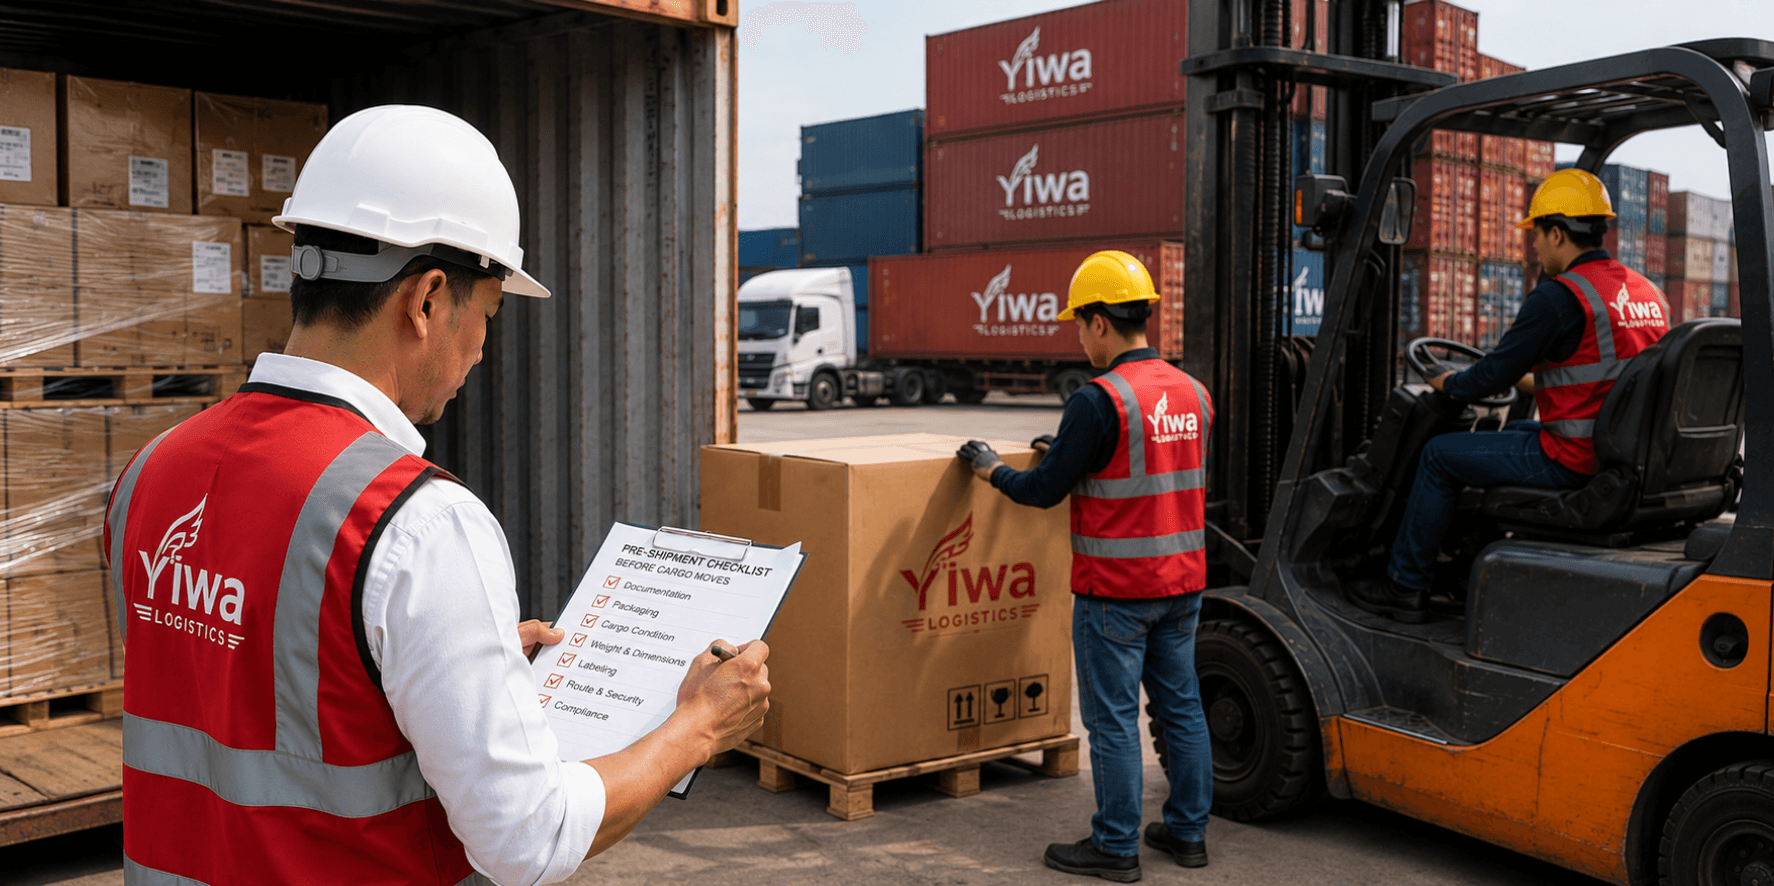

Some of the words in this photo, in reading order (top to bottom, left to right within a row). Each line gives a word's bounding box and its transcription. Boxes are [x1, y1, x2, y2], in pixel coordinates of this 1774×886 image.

[998, 48, 1092, 92] Yiwa
[996, 170, 1090, 207] Yiwa
[970, 291, 1058, 323] Yiwa
[1609, 301, 1662, 320] Yiwa
[1147, 412, 1198, 435] Yiwa
[615, 557, 657, 573] BEFORE
[656, 565, 693, 579] CARGO
[693, 572, 731, 586] MOVES
[621, 544, 706, 567] PRE-SHIPMENT
[706, 558, 773, 578] CHECKLIST
[138, 549, 245, 626] Yiwa
[623, 581, 692, 601] Documentation
[899, 561, 1036, 611] Yiwa
[611, 600, 660, 619] Packaging
[928, 607, 1018, 631] LOGISTICS
[155, 609, 225, 645] LOGISTICS
[601, 619, 630, 633] Cargo
[631, 626, 675, 642] Condition
[590, 639, 623, 654] Weight
[623, 647, 631, 656] &
[631, 648, 687, 667] Dimensions
[578, 659, 618, 678] Labeling
[566, 679, 595, 694] Route
[595, 687, 603, 696] &
[605, 689, 645, 706] Security
[554, 700, 610, 721] Compliance
